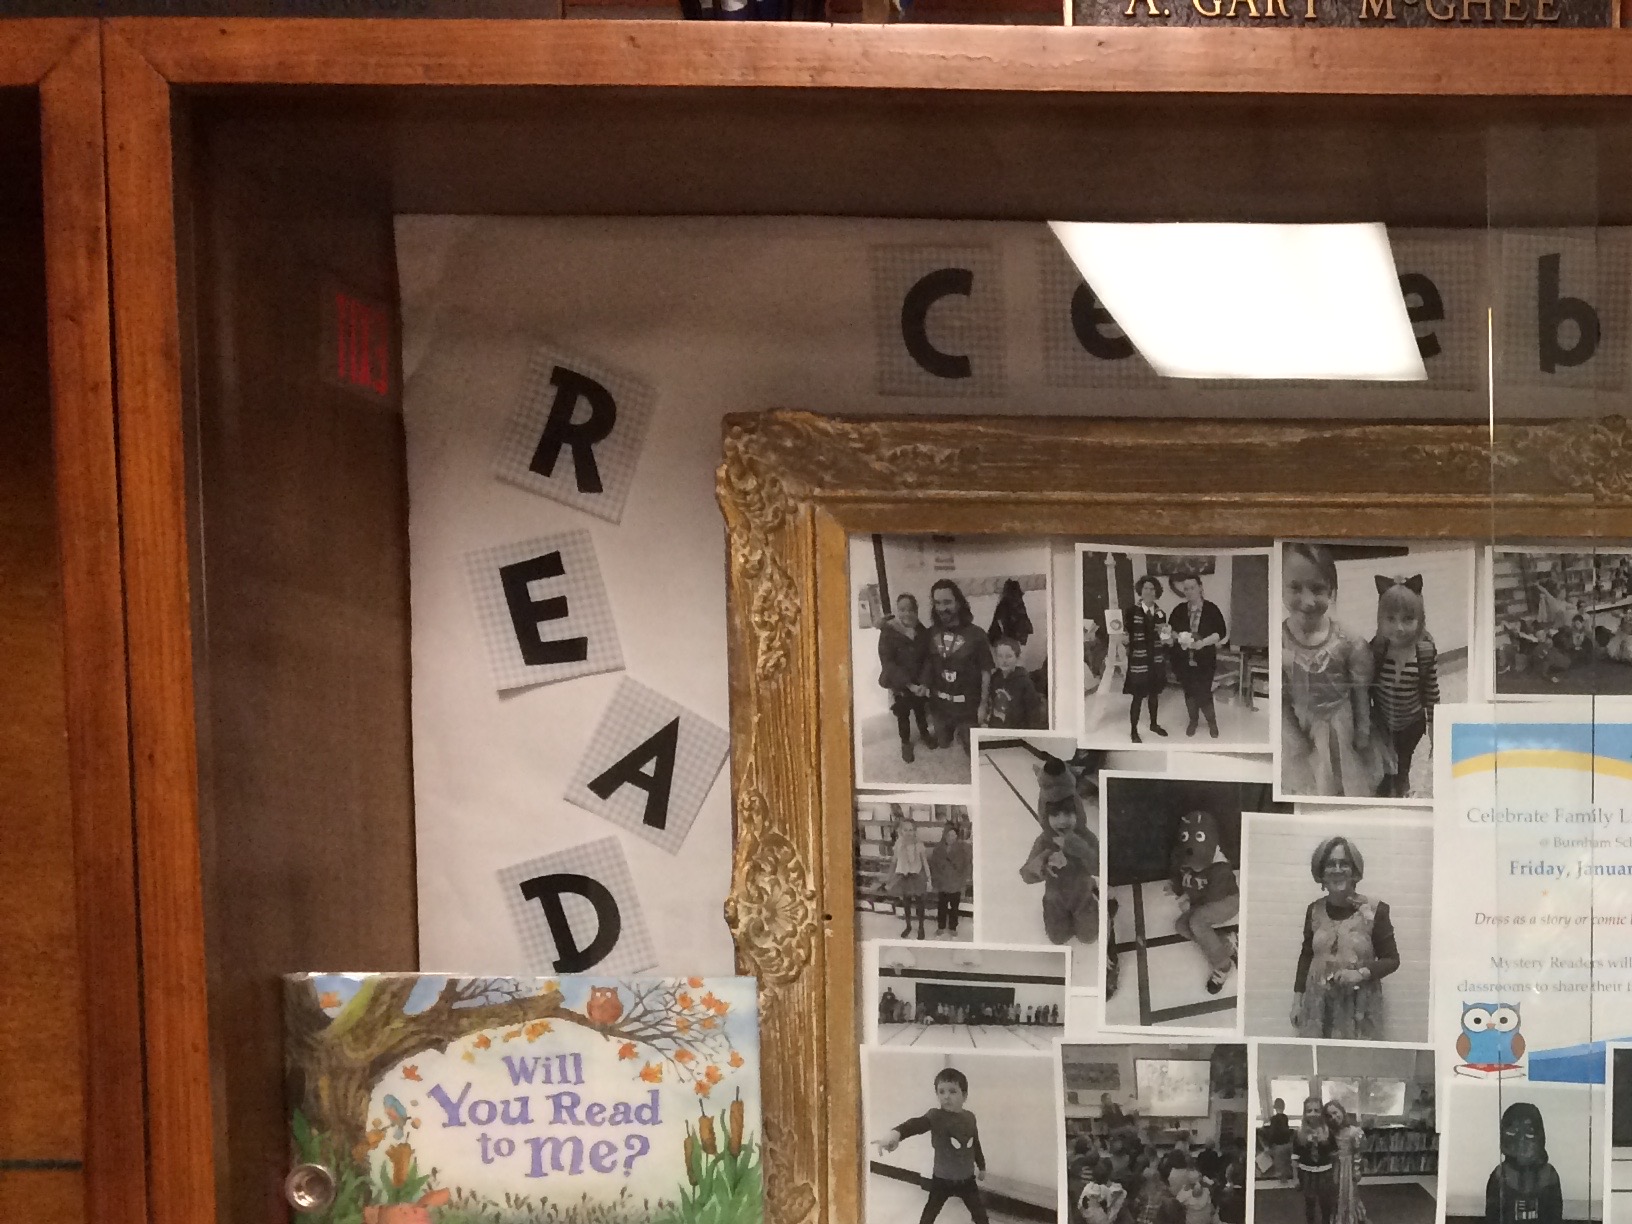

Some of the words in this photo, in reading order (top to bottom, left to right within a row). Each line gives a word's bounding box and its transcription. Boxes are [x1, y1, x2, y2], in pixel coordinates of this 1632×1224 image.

[1358, 0, 1560, 21] MGHEE
[1466, 808, 1549, 825] Celebrate
[1554, 808, 1613, 828] Family
[1553, 836, 1612, 848] Burnham
[1510, 861, 1571, 880] Friday,
[1474, 912, 1510, 926] Dress
[1513, 915, 1526, 926] as
[1529, 915, 1537, 926] a
[1540, 913, 1572, 928] story
[1575, 914, 1588, 926] or
[1591, 913, 1627, 926] comic
[1490, 956, 1545, 972] Mystery
[1549, 956, 1604, 970] Readers
[1607, 956, 1632, 969] will
[1457, 979, 1532, 993] classrooms
[1535, 980, 1549, 993] to
[1552, 979, 1590, 993] share
[1590, 979, 1623, 993] their
[501, 1051, 586, 1087] Will
[427, 1081, 534, 1129] You
[545, 1089, 663, 1128] Read
[476, 1132, 516, 1165] to
